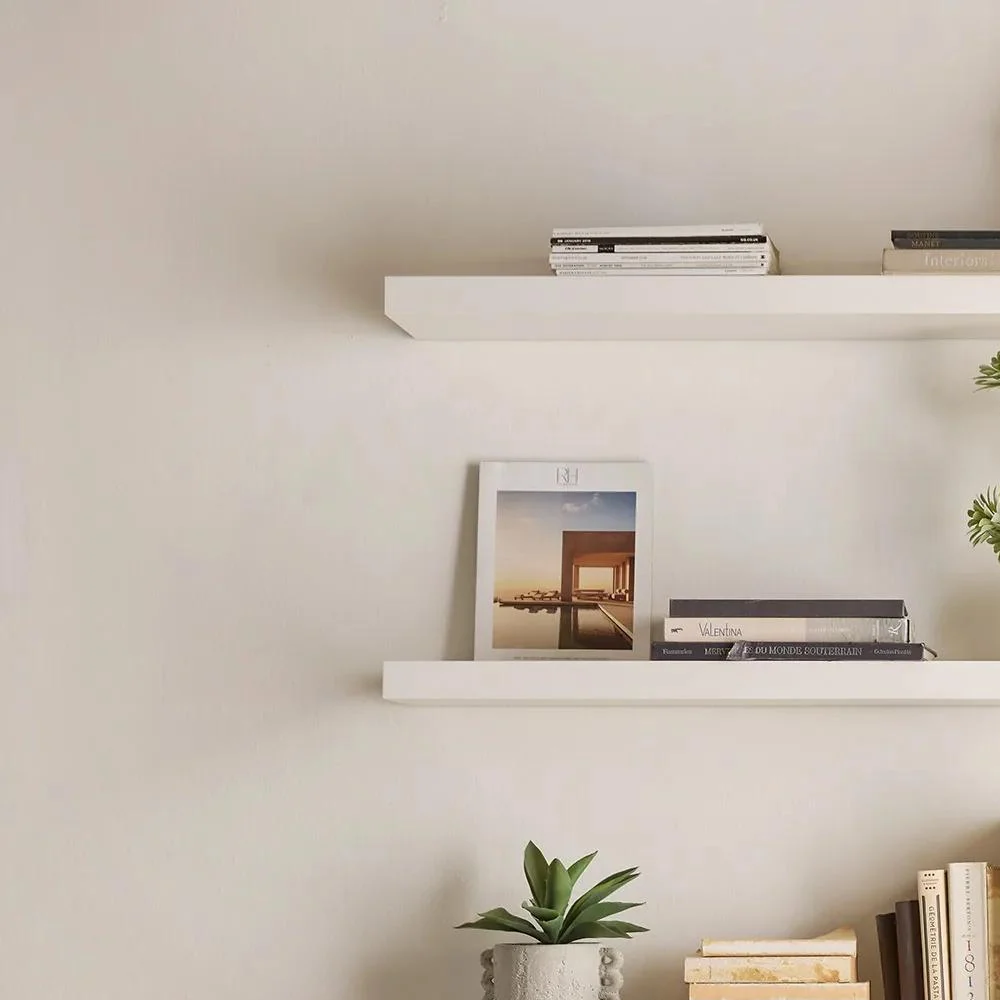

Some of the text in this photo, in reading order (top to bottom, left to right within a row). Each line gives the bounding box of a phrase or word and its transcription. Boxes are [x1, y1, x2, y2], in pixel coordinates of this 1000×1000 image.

[755, 647, 768, 655] DU
[769, 647, 802, 656] MONDE
[804, 647, 863, 656] SOUTERRAIN
[931, 951, 938, 963] DE
[932, 964, 939, 975] LA
[932, 975, 941, 1000] PASTA
